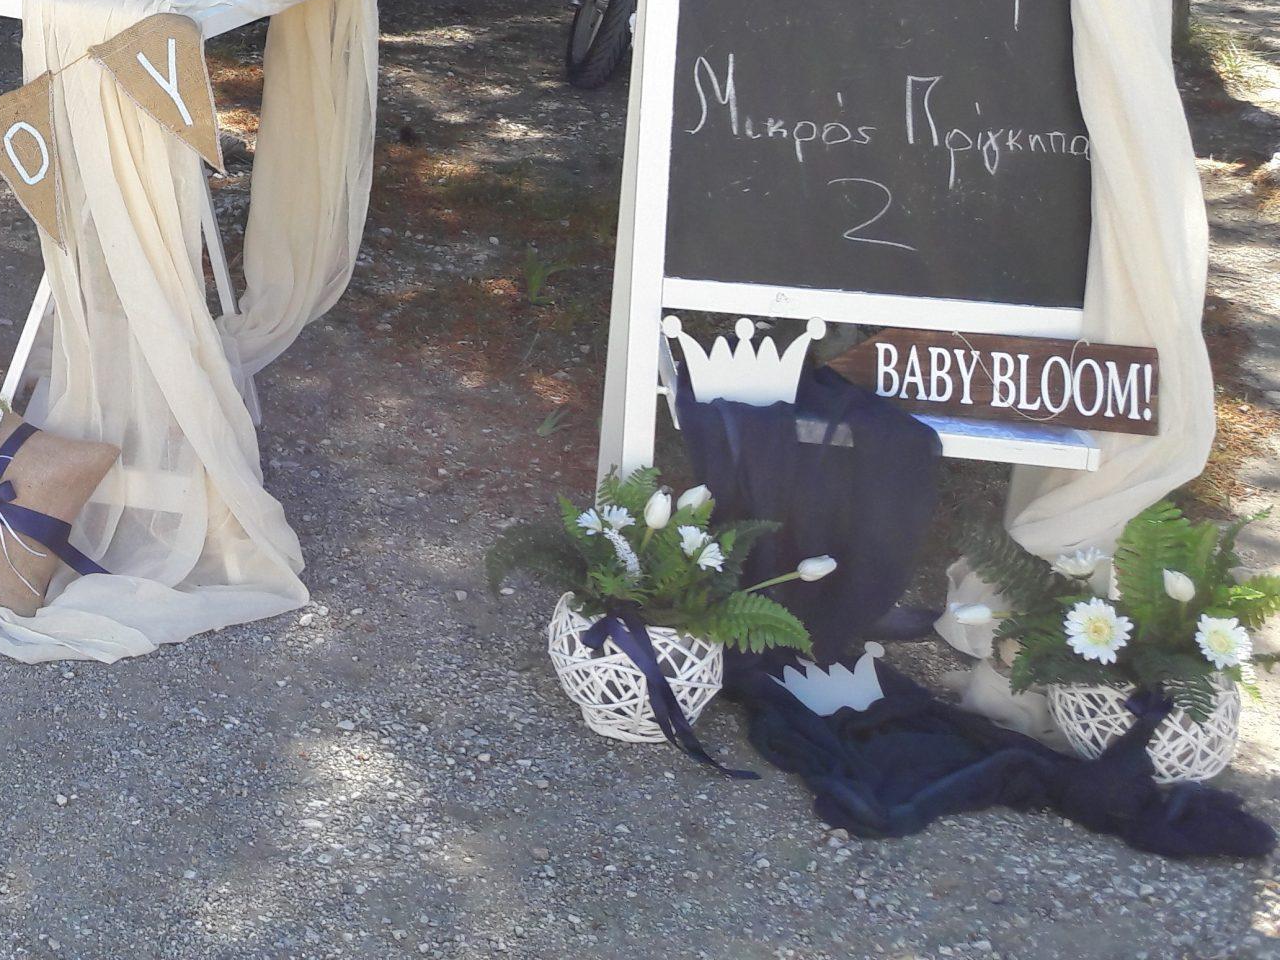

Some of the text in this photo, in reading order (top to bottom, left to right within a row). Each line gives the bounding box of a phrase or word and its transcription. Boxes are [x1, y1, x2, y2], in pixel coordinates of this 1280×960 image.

[684, 53, 877, 163] Μικρός
[826, 177, 918, 252] 2
[874, 342, 1153, 422] BABY BLOOM!
